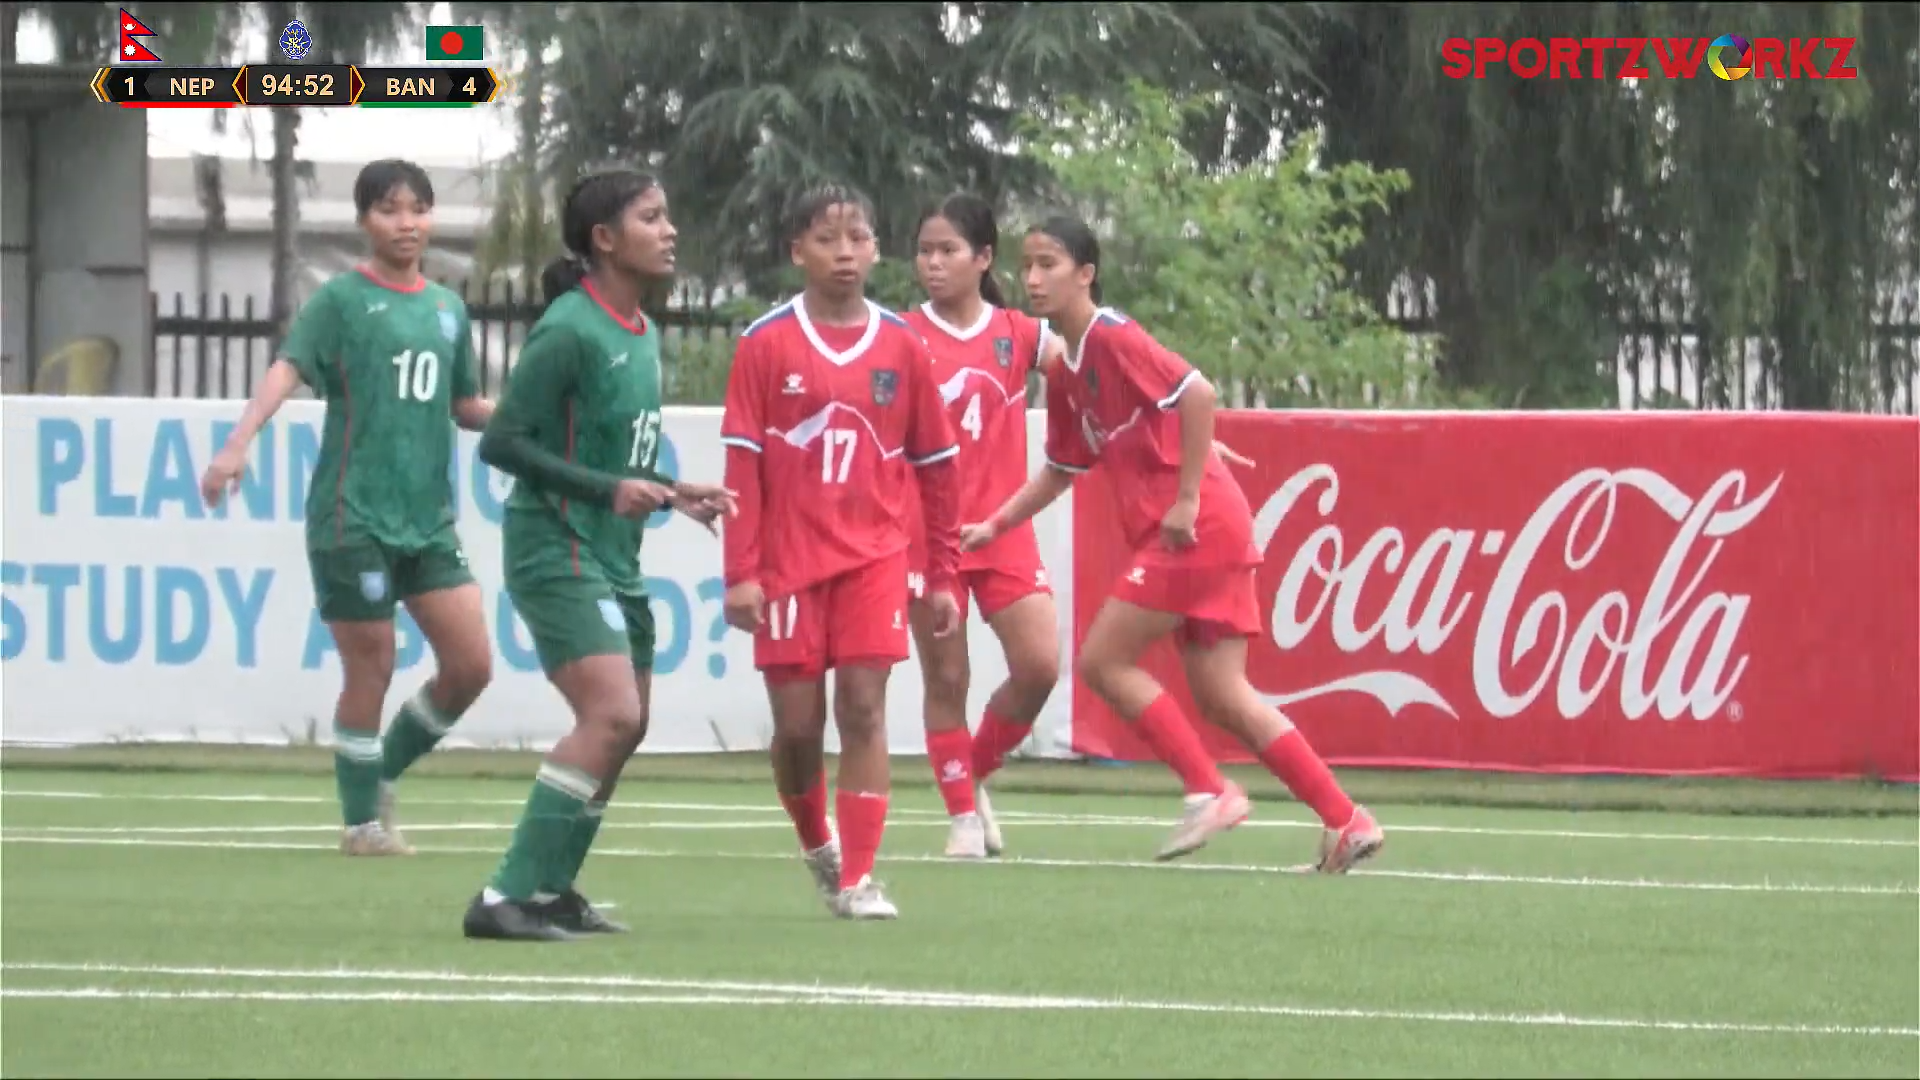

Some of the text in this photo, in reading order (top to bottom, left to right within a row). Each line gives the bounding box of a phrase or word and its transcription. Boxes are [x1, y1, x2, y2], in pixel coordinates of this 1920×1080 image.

[393, 349, 439, 402] 10
[627, 408, 661, 468] 15
[960, 392, 983, 441] 4
[822, 428, 857, 484] 17
[1, 560, 276, 669] STUDY
[1253, 463, 1785, 720] Coca-Cola
